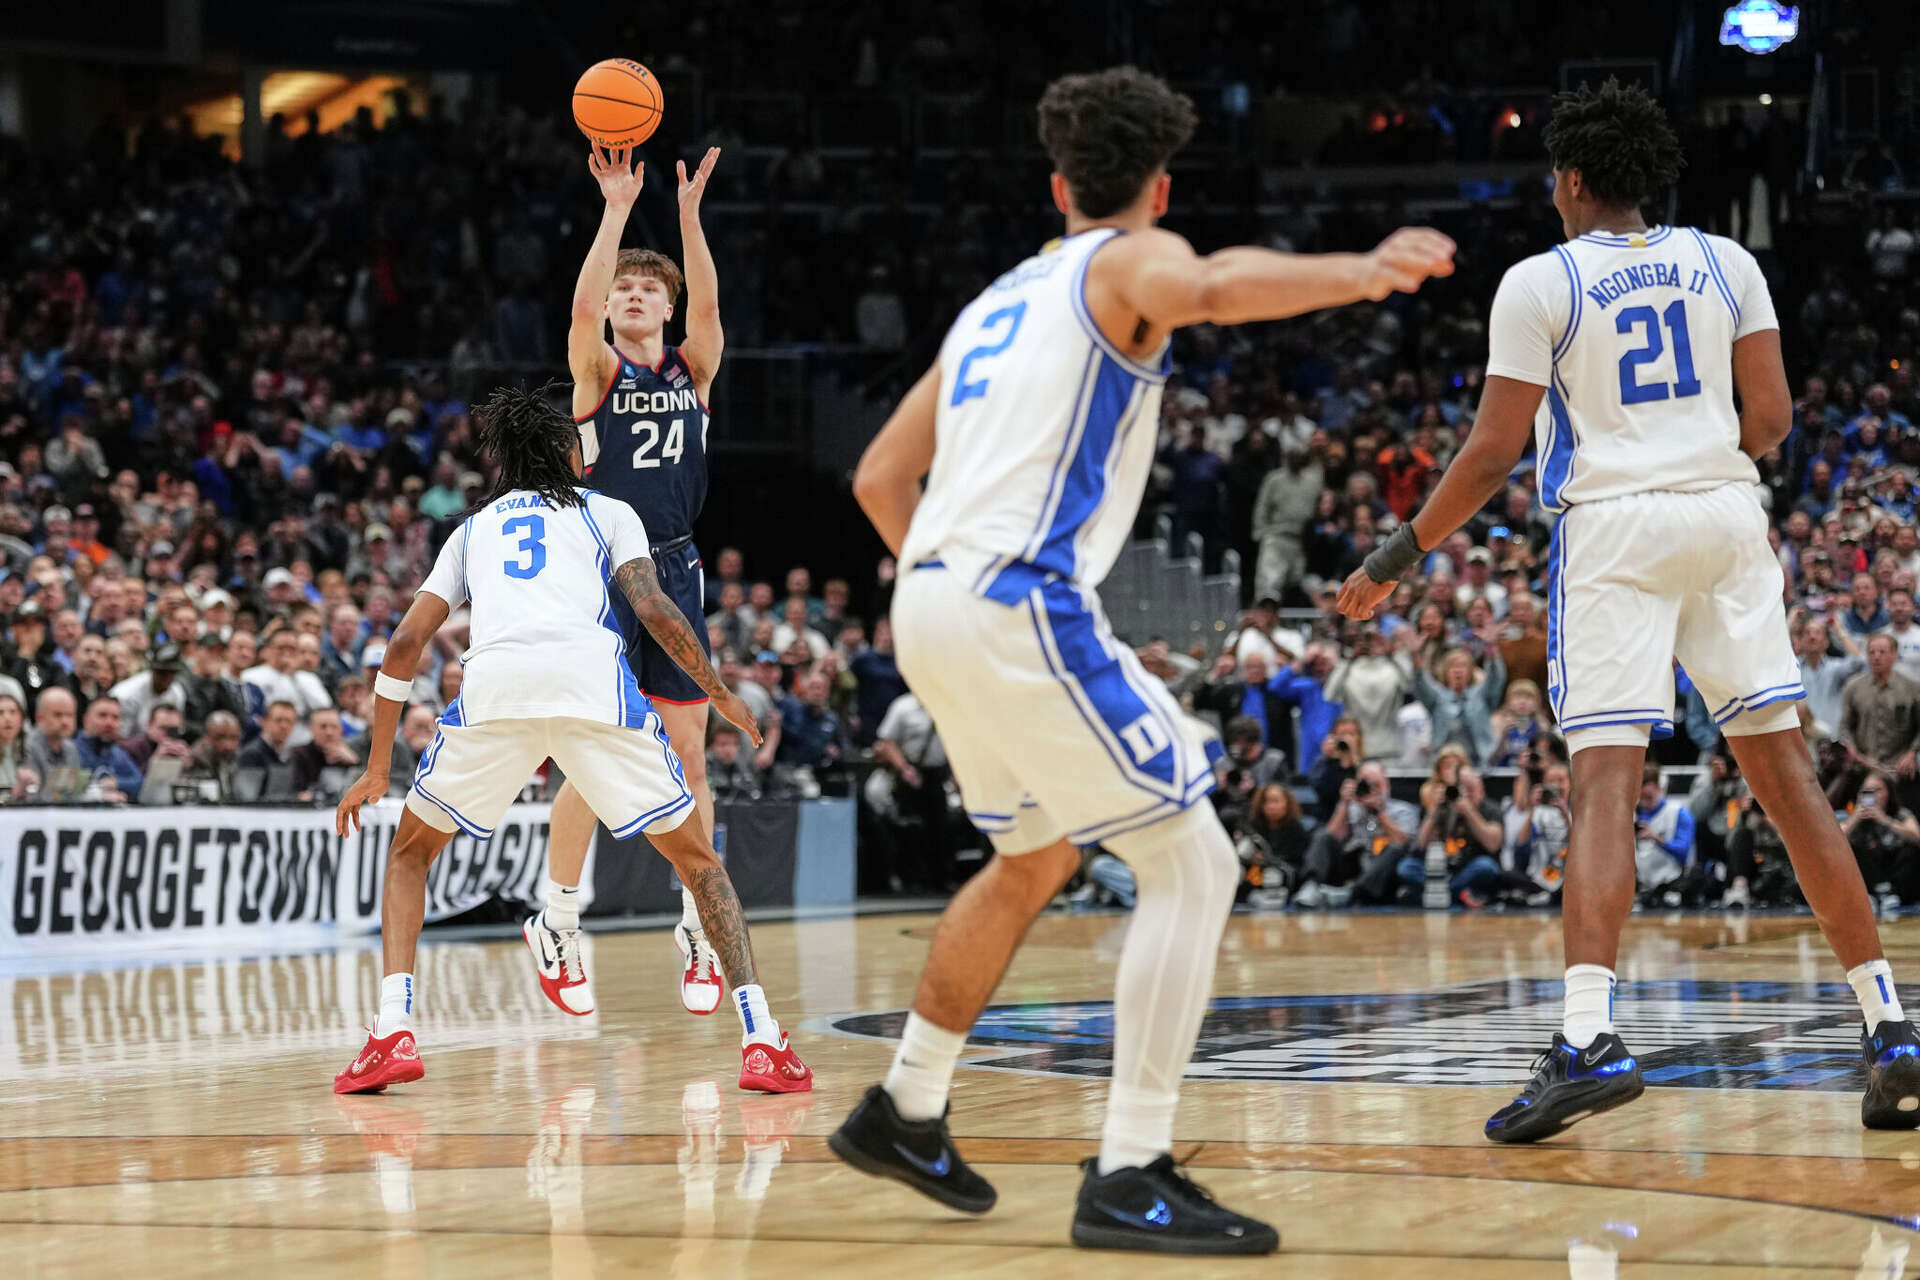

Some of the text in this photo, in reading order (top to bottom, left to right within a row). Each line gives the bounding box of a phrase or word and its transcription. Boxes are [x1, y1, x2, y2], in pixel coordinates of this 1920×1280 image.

[1586, 263, 1709, 310] NGONGBA II
[950, 299, 1027, 408] 2
[1615, 299, 1702, 406] 21
[612, 388, 698, 415] UCONN
[631, 418, 685, 470] 24
[502, 513, 547, 580] 3
[12, 827, 344, 935] GEORGETOWN
